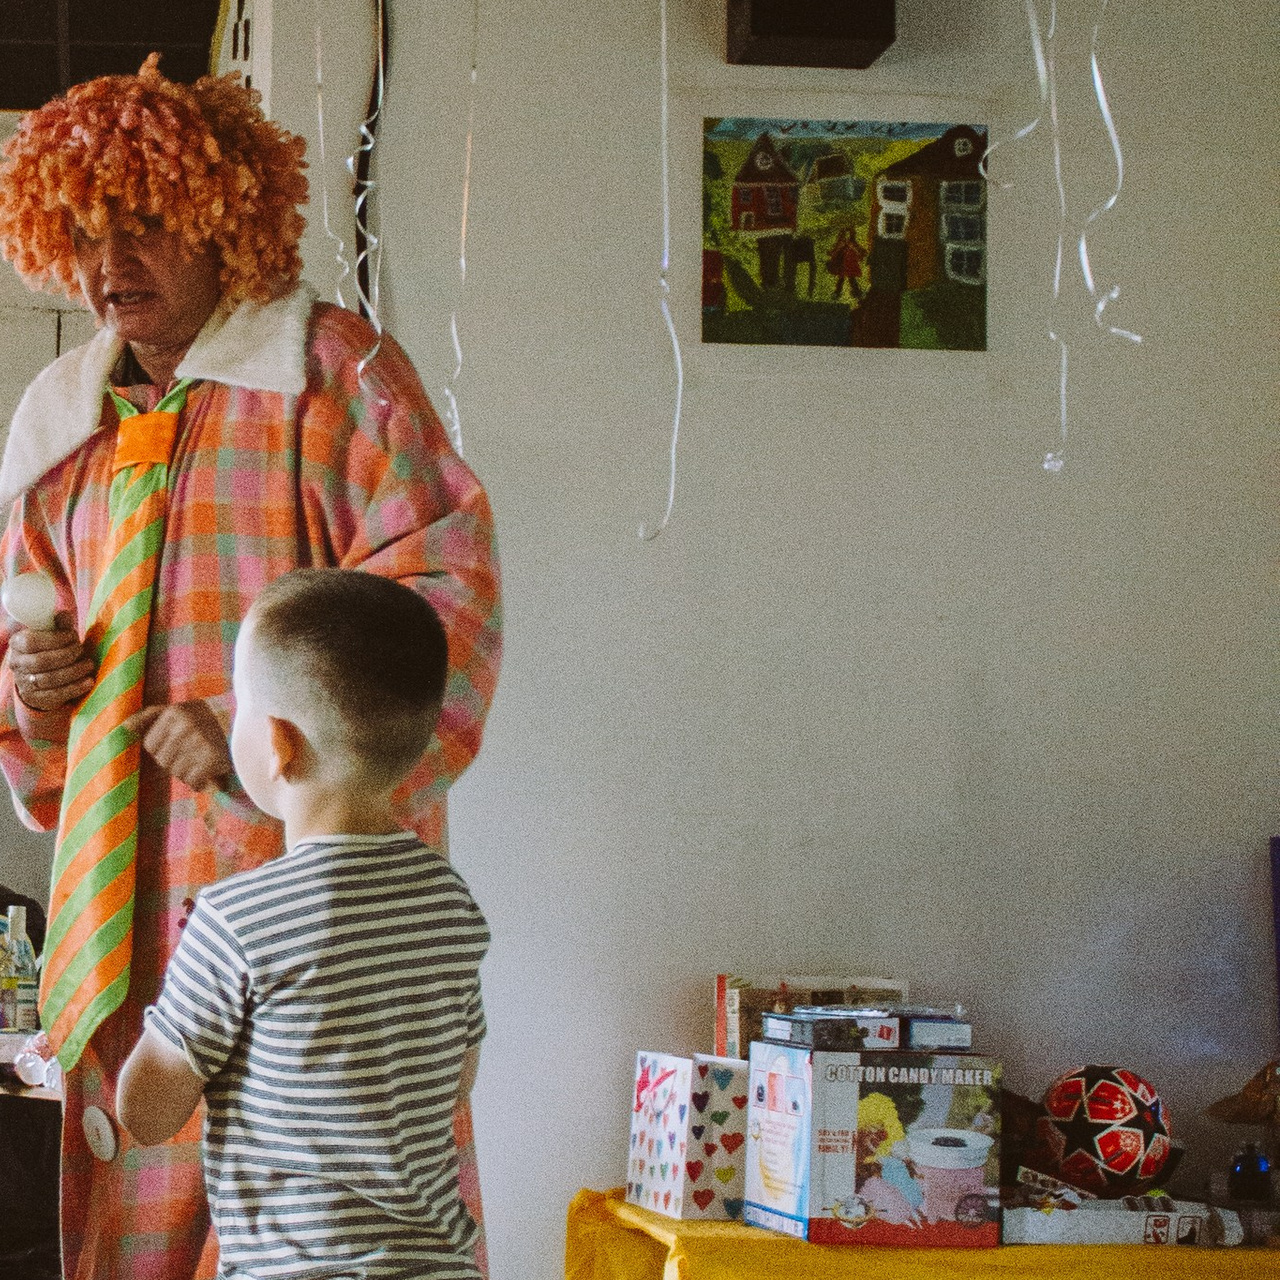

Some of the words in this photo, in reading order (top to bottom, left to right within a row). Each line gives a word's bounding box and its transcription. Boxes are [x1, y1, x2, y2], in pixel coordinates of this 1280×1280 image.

[825, 1064, 886, 1083] COTTON
[888, 1066, 940, 1084] CANDY
[942, 1068, 992, 1085] MAKER
